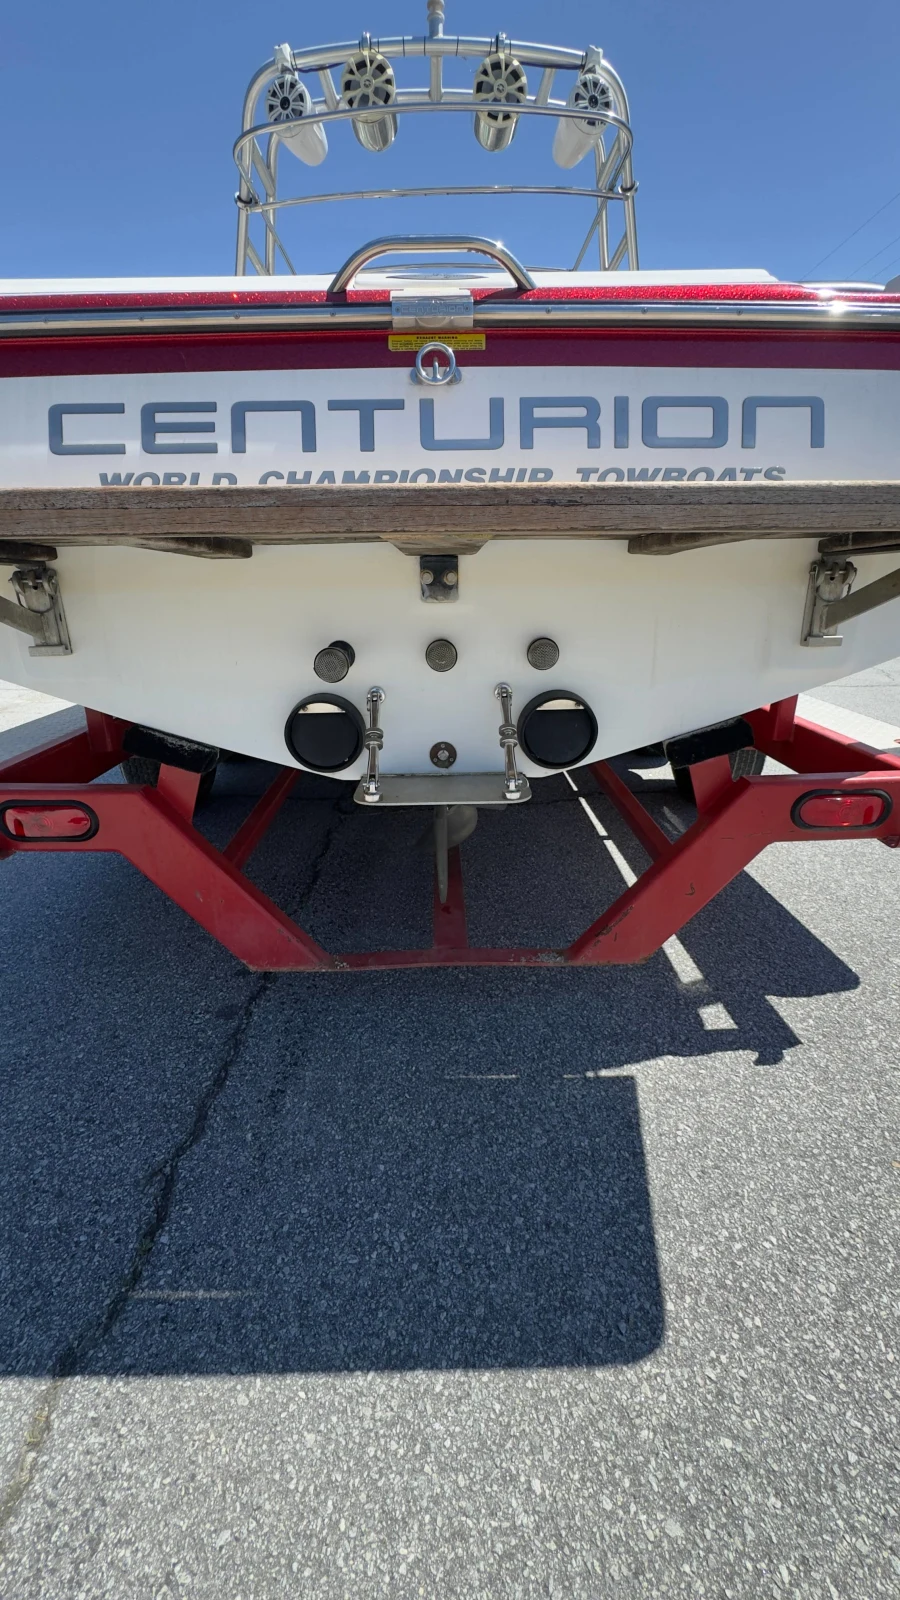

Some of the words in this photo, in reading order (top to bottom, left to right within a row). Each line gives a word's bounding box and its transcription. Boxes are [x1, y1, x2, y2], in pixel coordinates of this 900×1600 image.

[48, 395, 825, 455] CENTURION
[99, 471, 238, 486] WORLD
[258, 467, 554, 485] CHAMPIONSHIP
[576, 465, 787, 482] TOWBOATS
